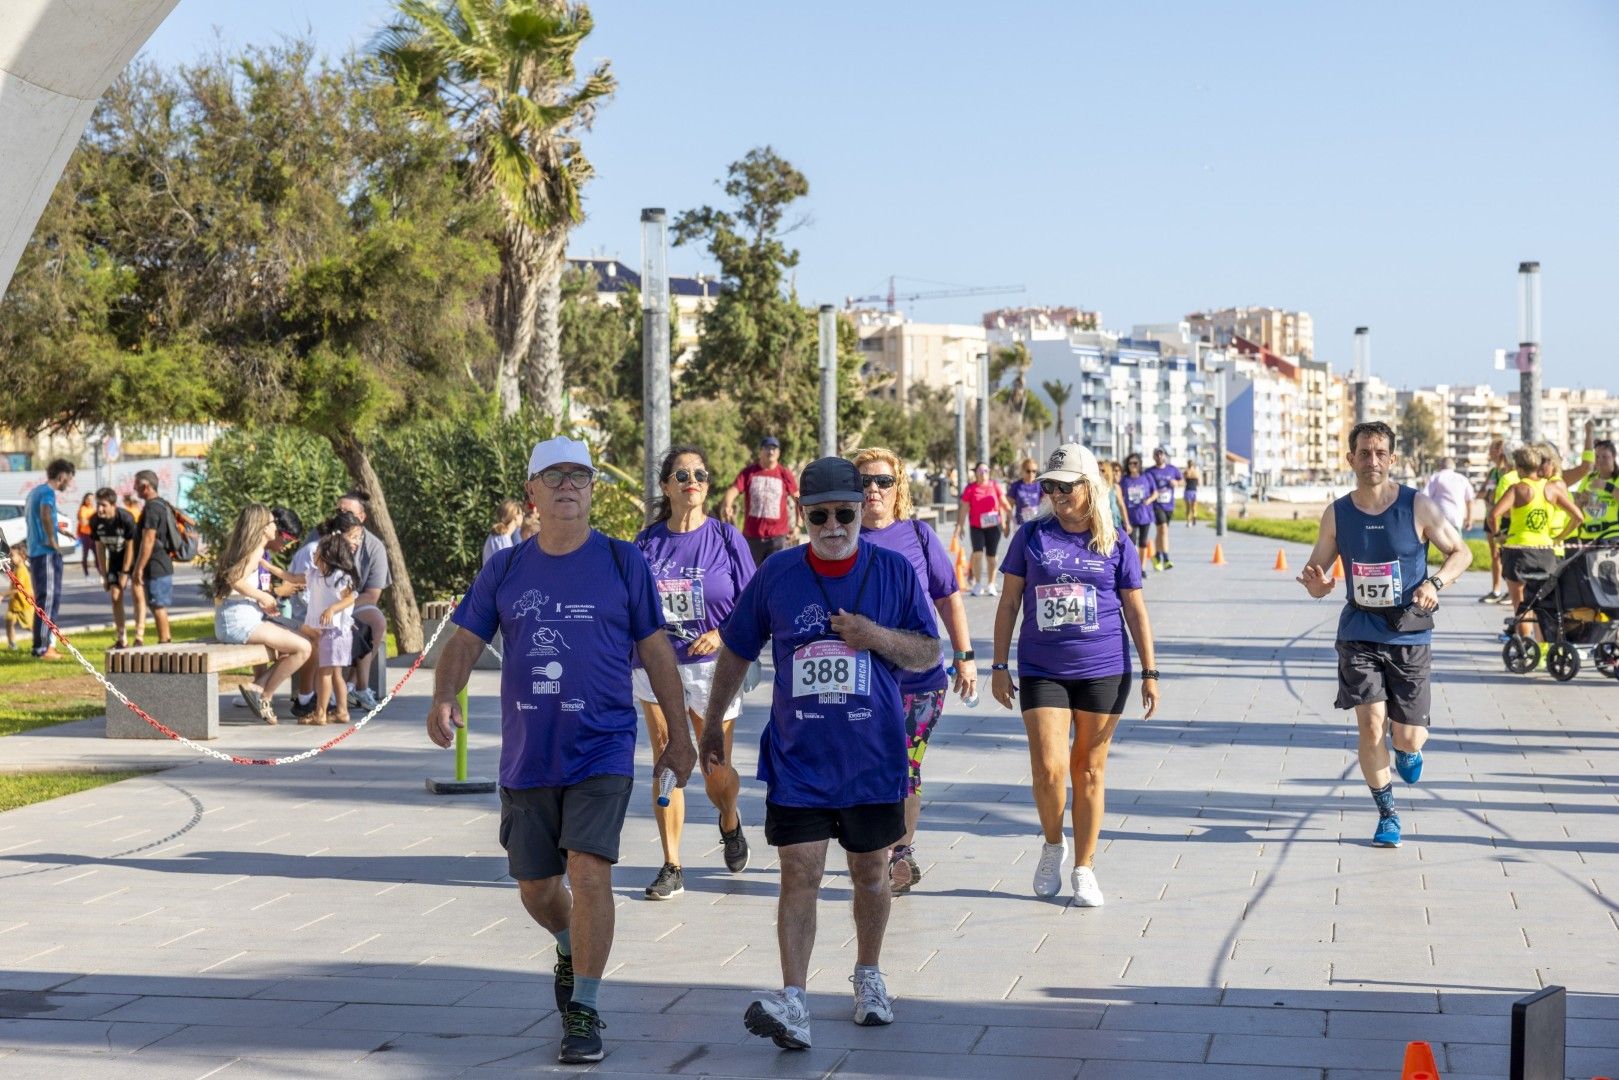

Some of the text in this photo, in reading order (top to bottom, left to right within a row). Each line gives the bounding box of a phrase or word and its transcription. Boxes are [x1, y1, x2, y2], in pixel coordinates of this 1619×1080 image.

[1357, 584, 1389, 598] 157
[665, 593, 689, 613] 13
[1044, 598, 1080, 619] 354
[802, 658, 849, 685] 388
[858, 659, 867, 692] MARCHA
[533, 681, 560, 694] AGAMED
